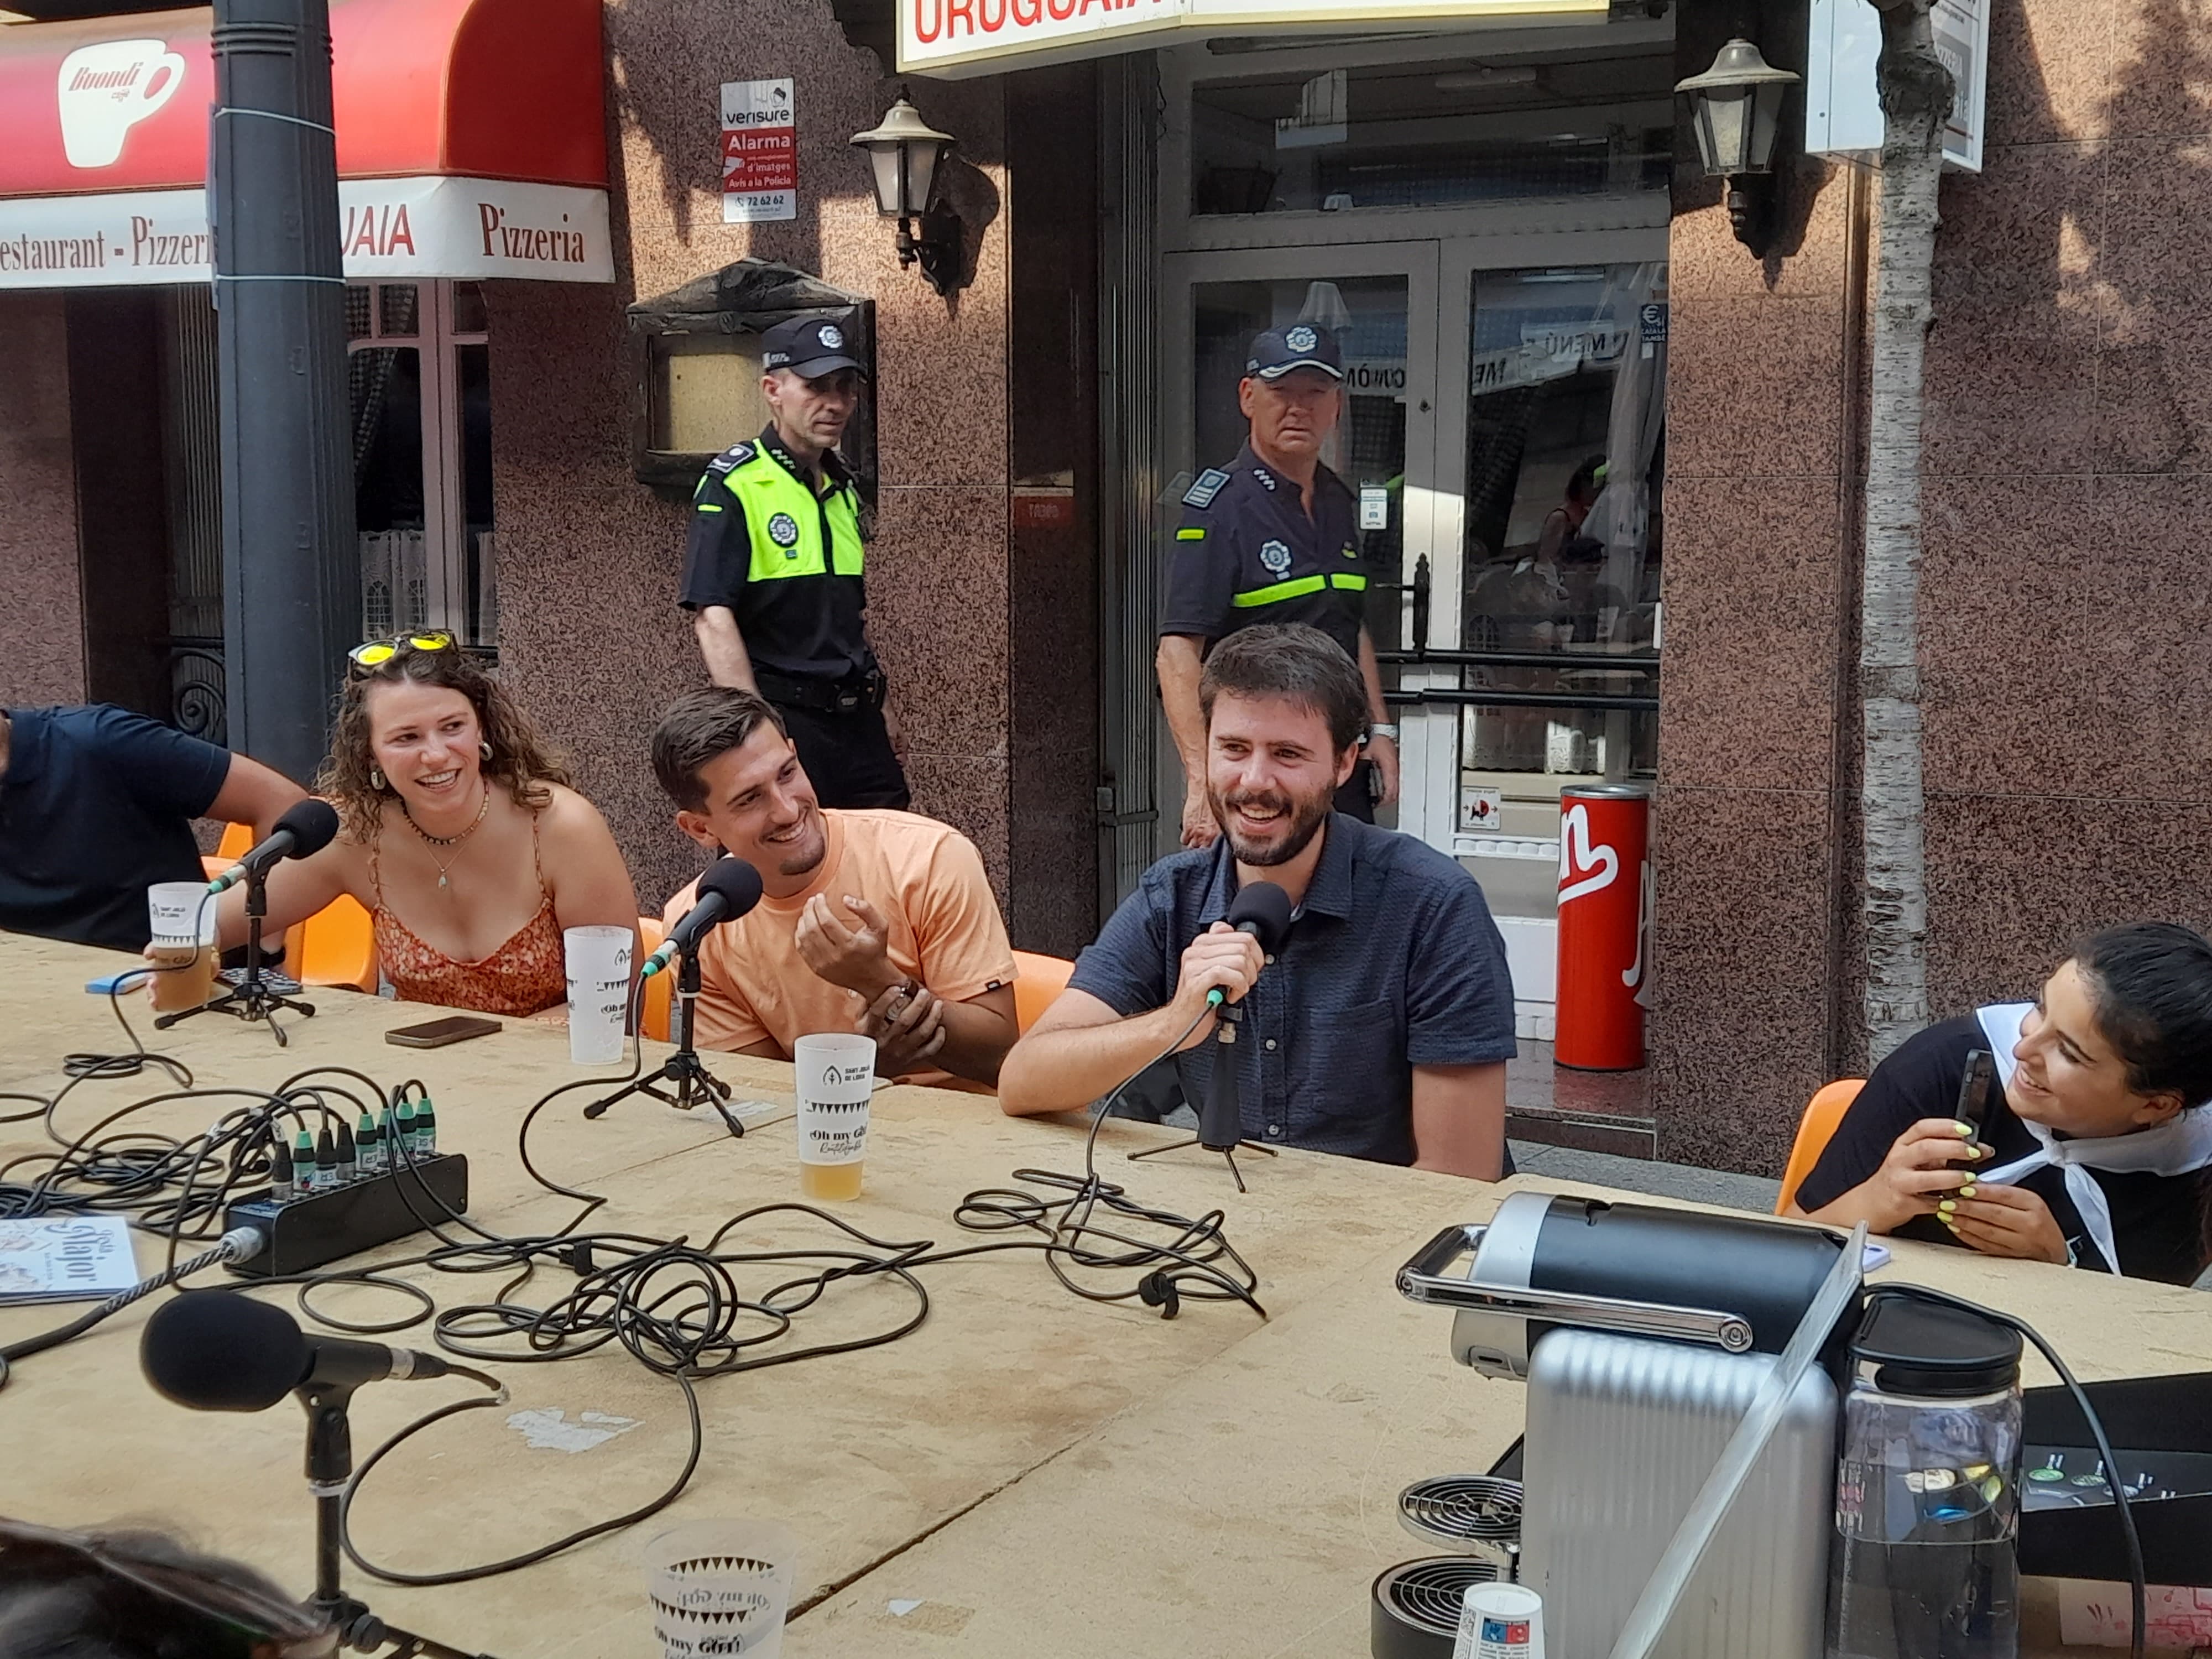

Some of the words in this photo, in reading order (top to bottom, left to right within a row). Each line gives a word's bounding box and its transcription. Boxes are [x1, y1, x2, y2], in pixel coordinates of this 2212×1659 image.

[915, 0, 1161, 43] URUG
[68, 61, 144, 91] Buondi
[726, 109, 790, 124] verisure
[728, 133, 791, 152] Alarma
[754, 176, 763, 186] la
[747, 196, 758, 206] 72
[760, 195, 771, 205] 62
[773, 195, 784, 205] 62
[478, 203, 585, 263] Pizzeria
